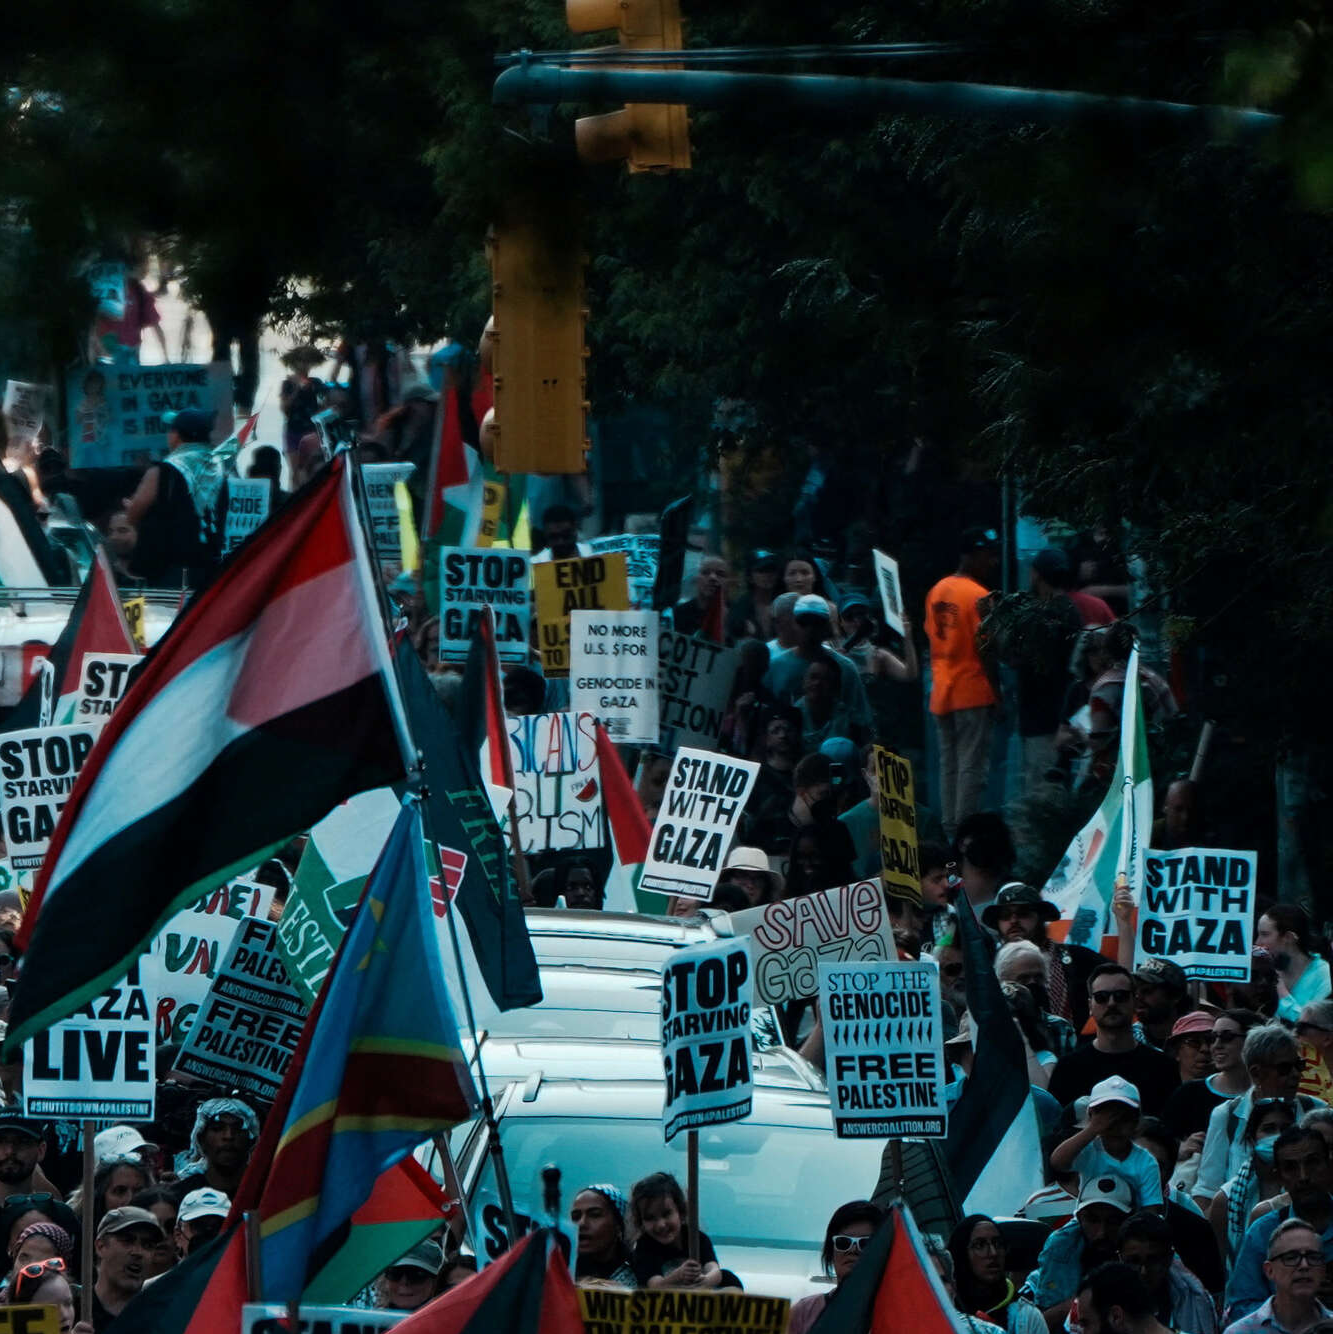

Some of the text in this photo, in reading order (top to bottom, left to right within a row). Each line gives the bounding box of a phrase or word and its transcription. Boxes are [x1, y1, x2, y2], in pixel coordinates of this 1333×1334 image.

[445, 554, 526, 588] STOP
[556, 558, 606, 588] END
[444, 590, 526, 604] STARVING
[563, 587, 606, 613] ALL
[588, 625, 647, 638] NO MORE
[544, 649, 563, 666] TO
[584, 643, 608, 656] U.S.
[576, 678, 642, 690] GENOCIDE
[599, 696, 638, 708] GAZA
[673, 758, 749, 798] STAND
[667, 789, 737, 826] WITH
[651, 823, 724, 872] GAZA
[1145, 855, 1250, 889] STAND
[1142, 887, 1249, 915] WITH
[1141, 917, 1248, 956] GAZA
[663, 949, 749, 1017] STOP
[829, 969, 929, 992] STOP THE
[829, 990, 933, 1021] GENOCIDE
[662, 1005, 751, 1049] STARVING
[31, 1029, 150, 1083] LIVE
[835, 1052, 935, 1081] FREE
[837, 1079, 938, 1111] PALESTINE
[841, 1119, 942, 1136] ANSWERCOALITION.ORG
[631, 1291, 784, 1326] STAND WITH
